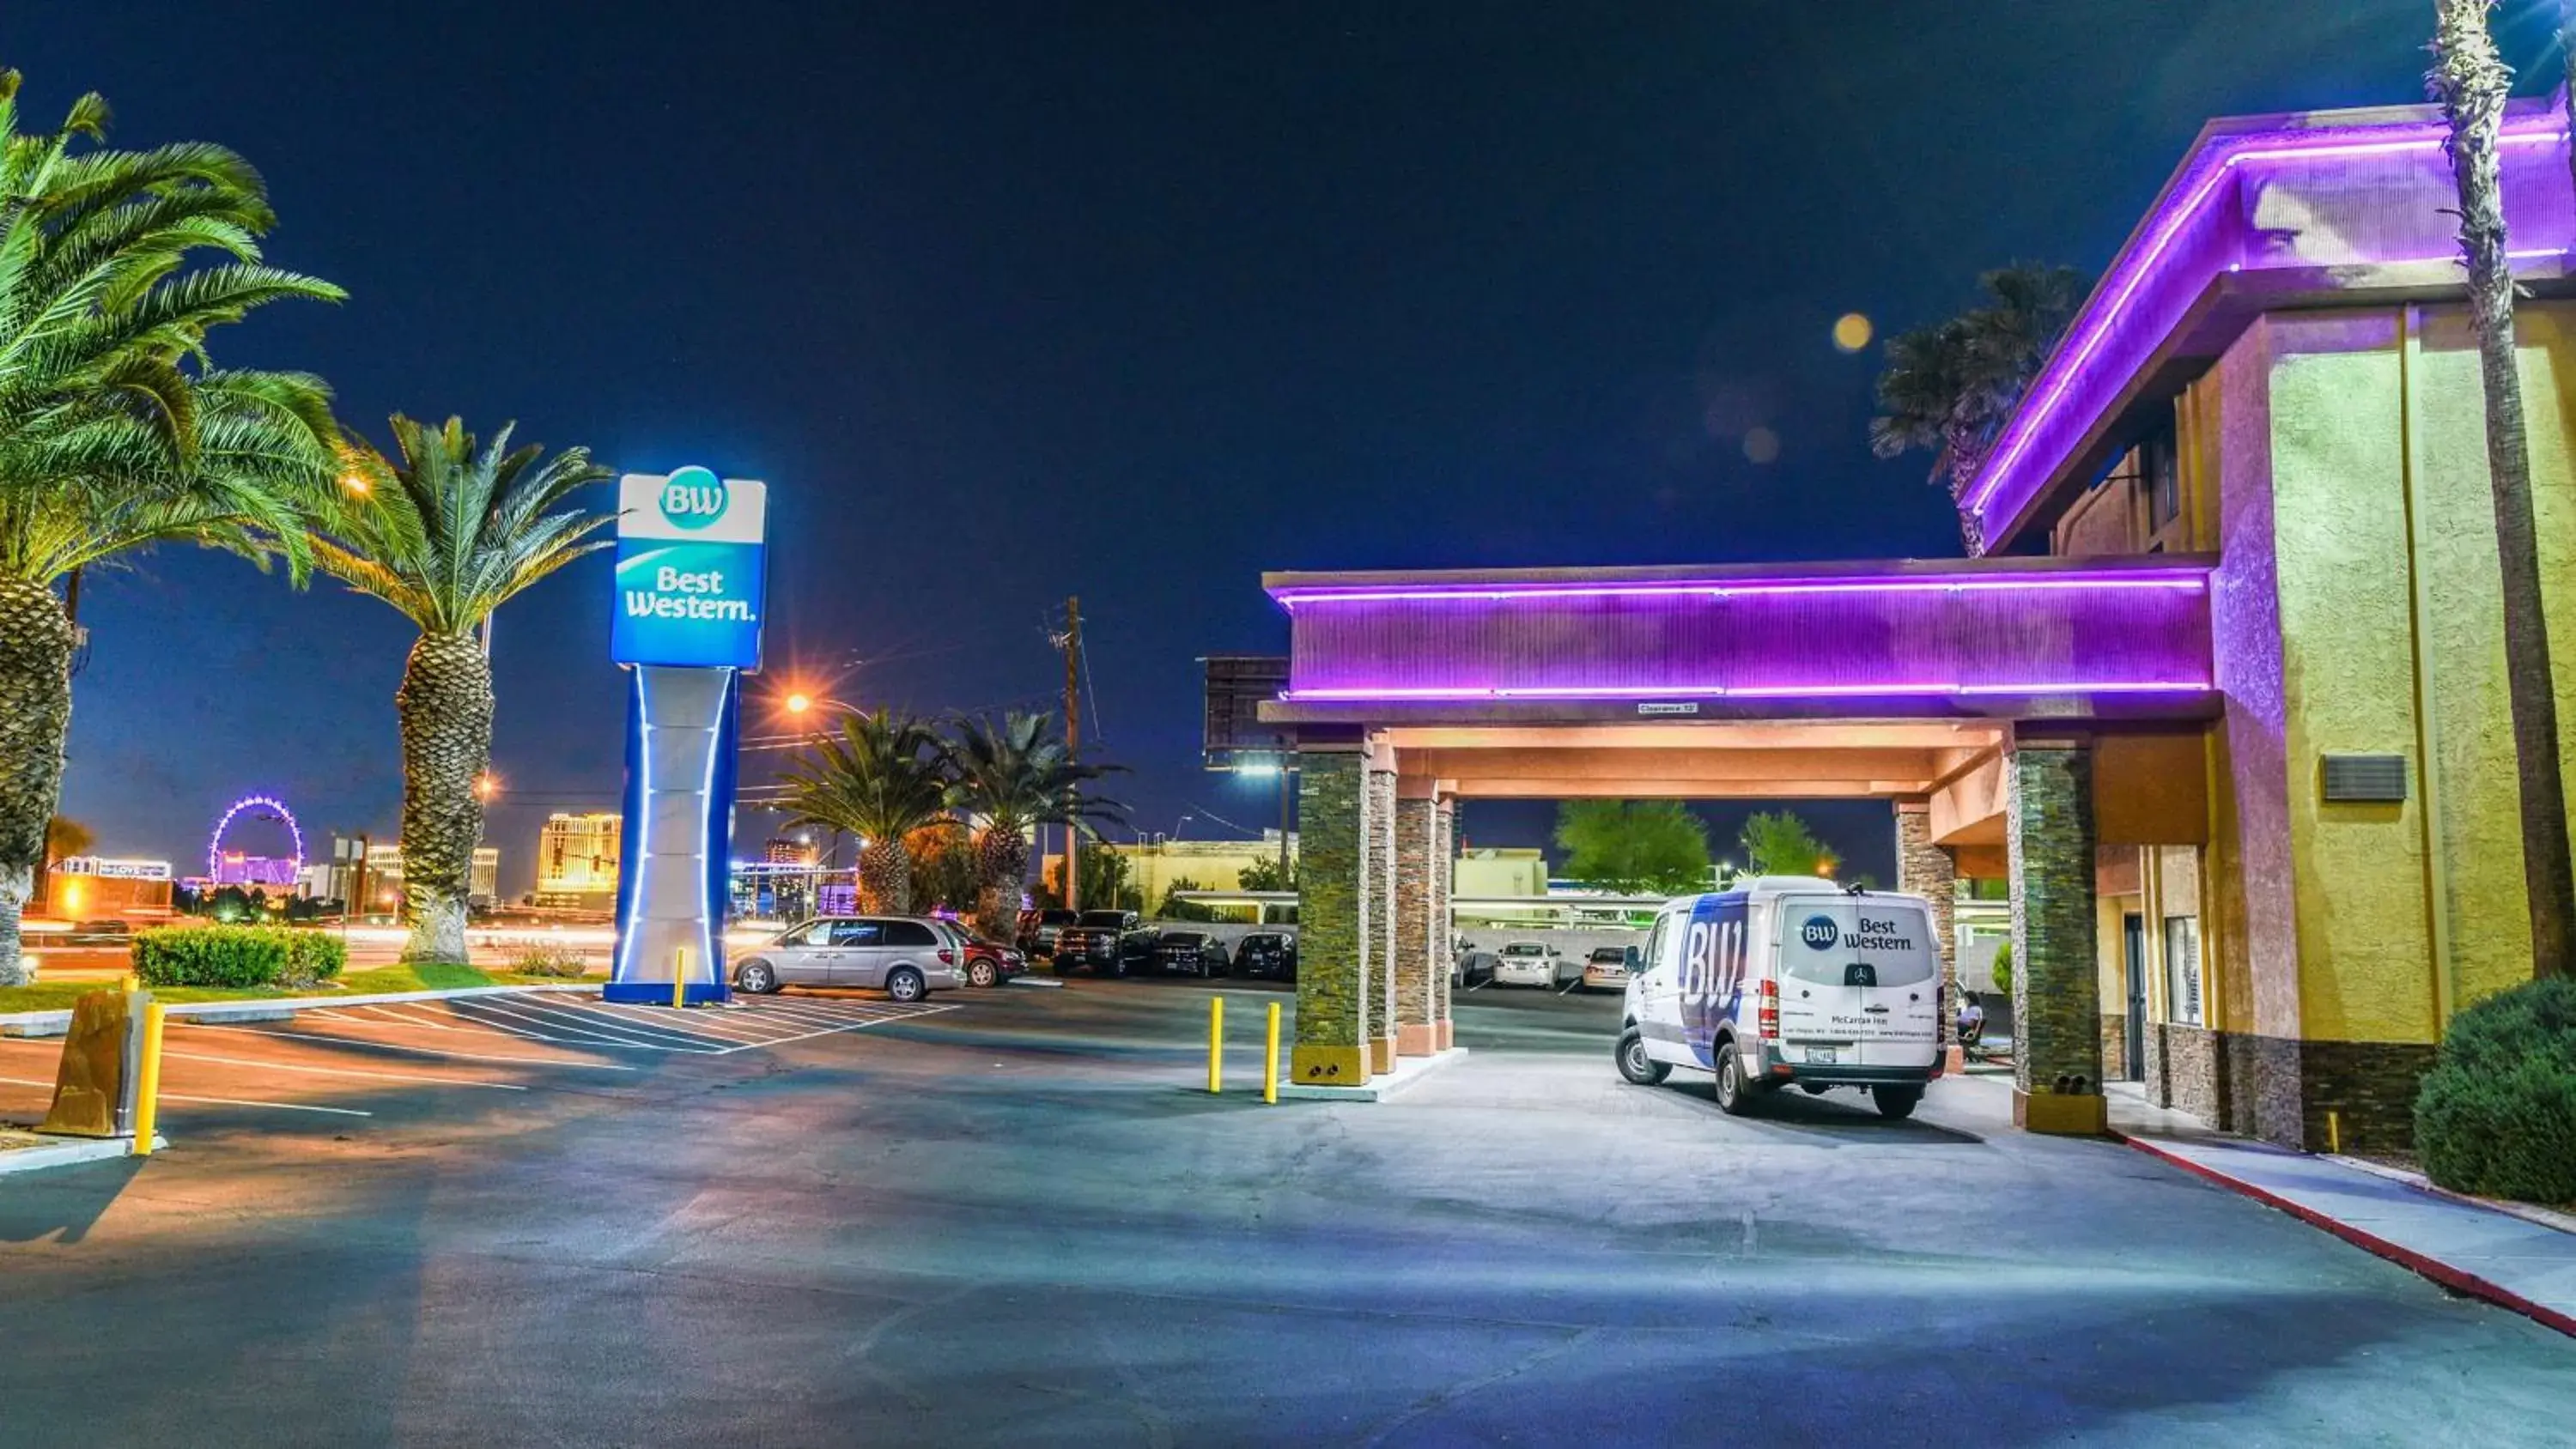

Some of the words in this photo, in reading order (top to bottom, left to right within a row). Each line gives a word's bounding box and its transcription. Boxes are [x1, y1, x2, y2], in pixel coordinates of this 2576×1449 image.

[665, 485, 723, 515] BW
[657, 566, 723, 594] Best
[1806, 925, 1836, 942] BW
[1860, 918, 1896, 934] Best
[1683, 920, 1742, 1009] BW
